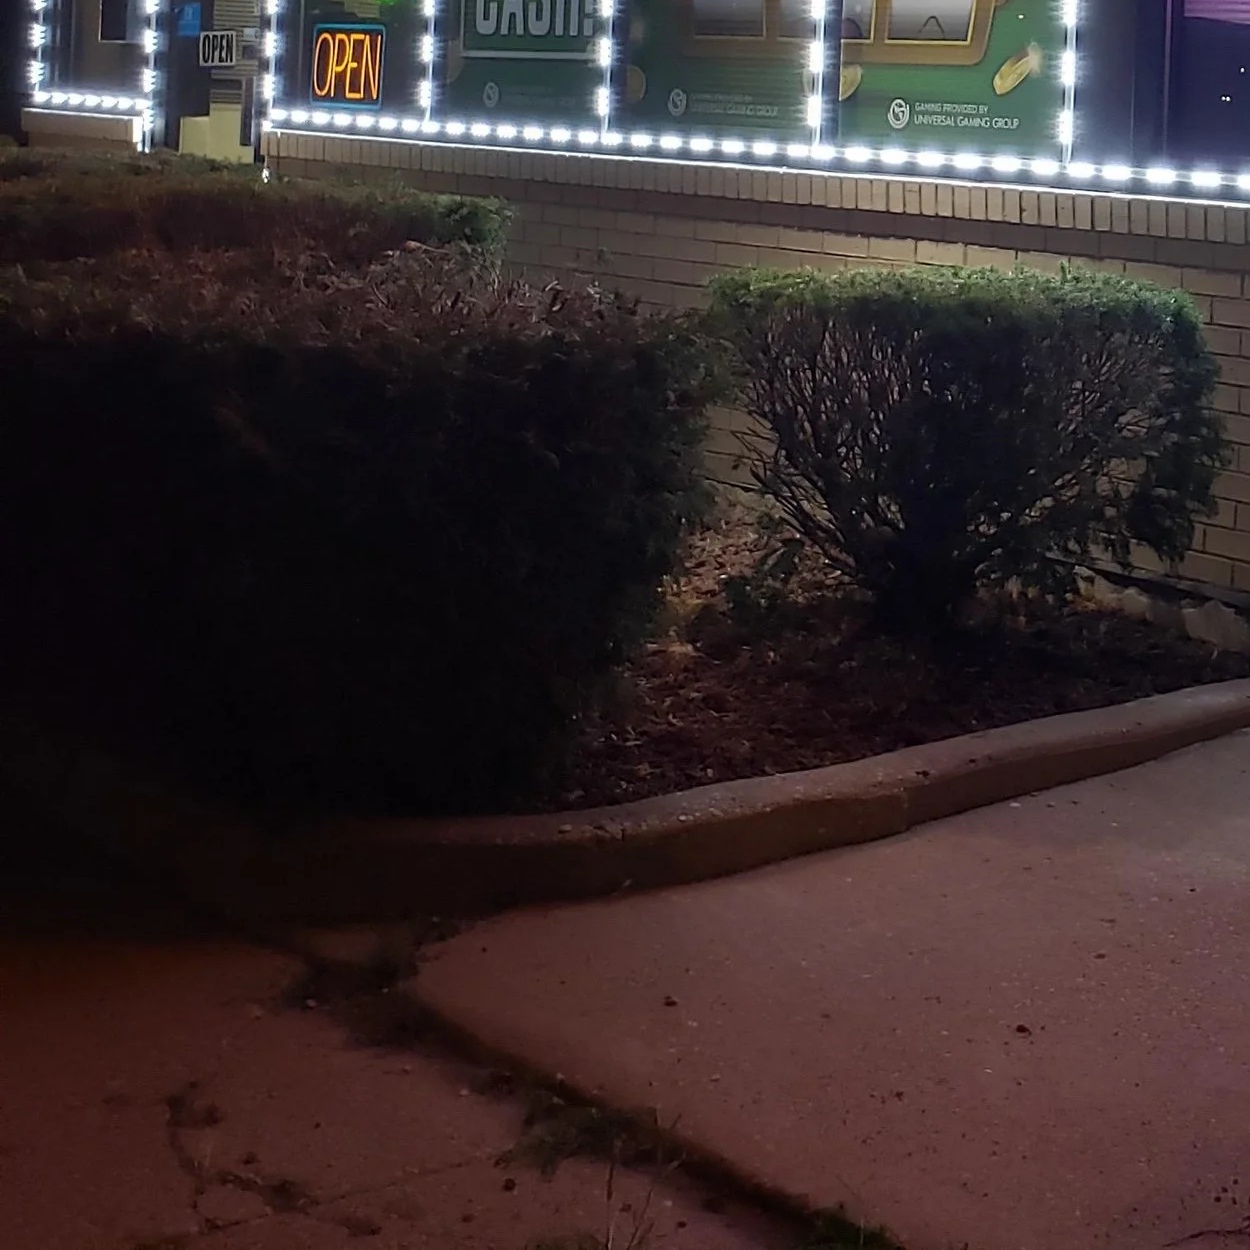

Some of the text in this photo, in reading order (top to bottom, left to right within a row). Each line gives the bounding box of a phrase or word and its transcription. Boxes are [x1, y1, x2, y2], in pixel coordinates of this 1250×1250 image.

[202, 34, 234, 64] OPEN
[314, 32, 382, 100] OPEN
[914, 114, 1019, 129] UNIVERSAL GAMING GROUP
